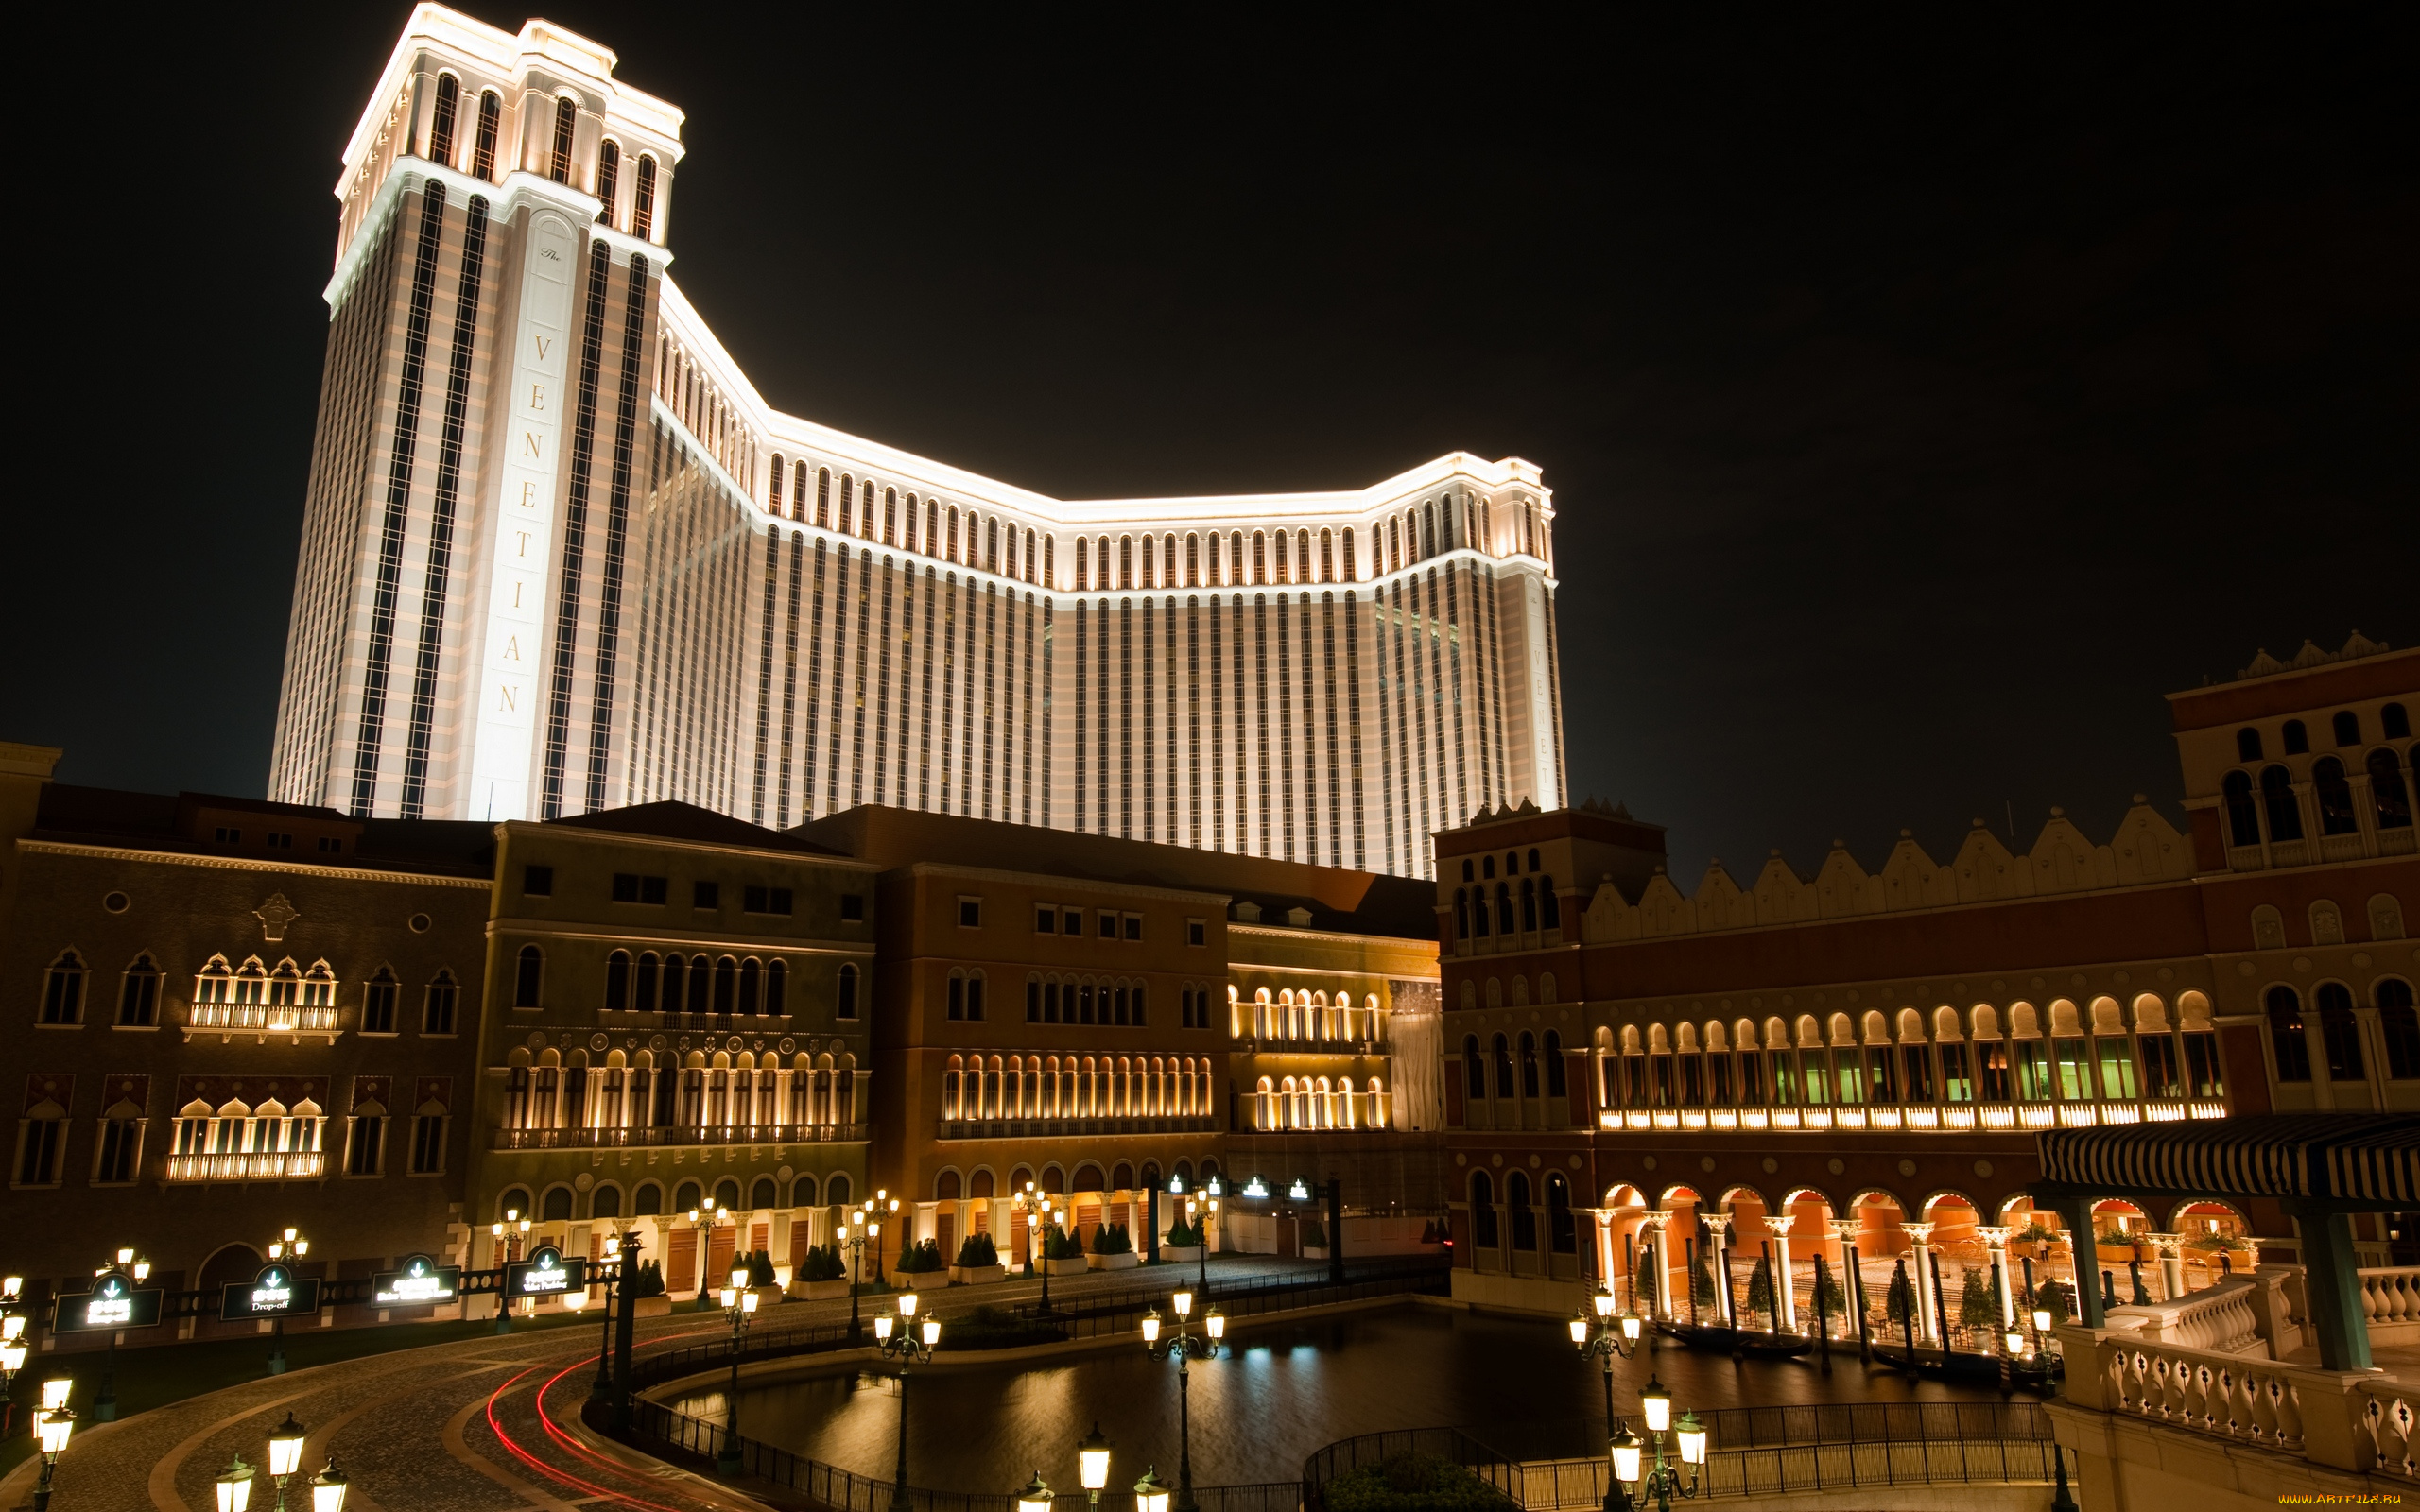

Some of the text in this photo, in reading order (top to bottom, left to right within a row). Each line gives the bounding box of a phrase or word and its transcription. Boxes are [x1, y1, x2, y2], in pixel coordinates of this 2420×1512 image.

[541, 248, 562, 262] The
[499, 334, 551, 713] VENETIAN
[1534, 650, 1548, 812] VENETI
[251, 1300, 289, 1311] Drop-off
